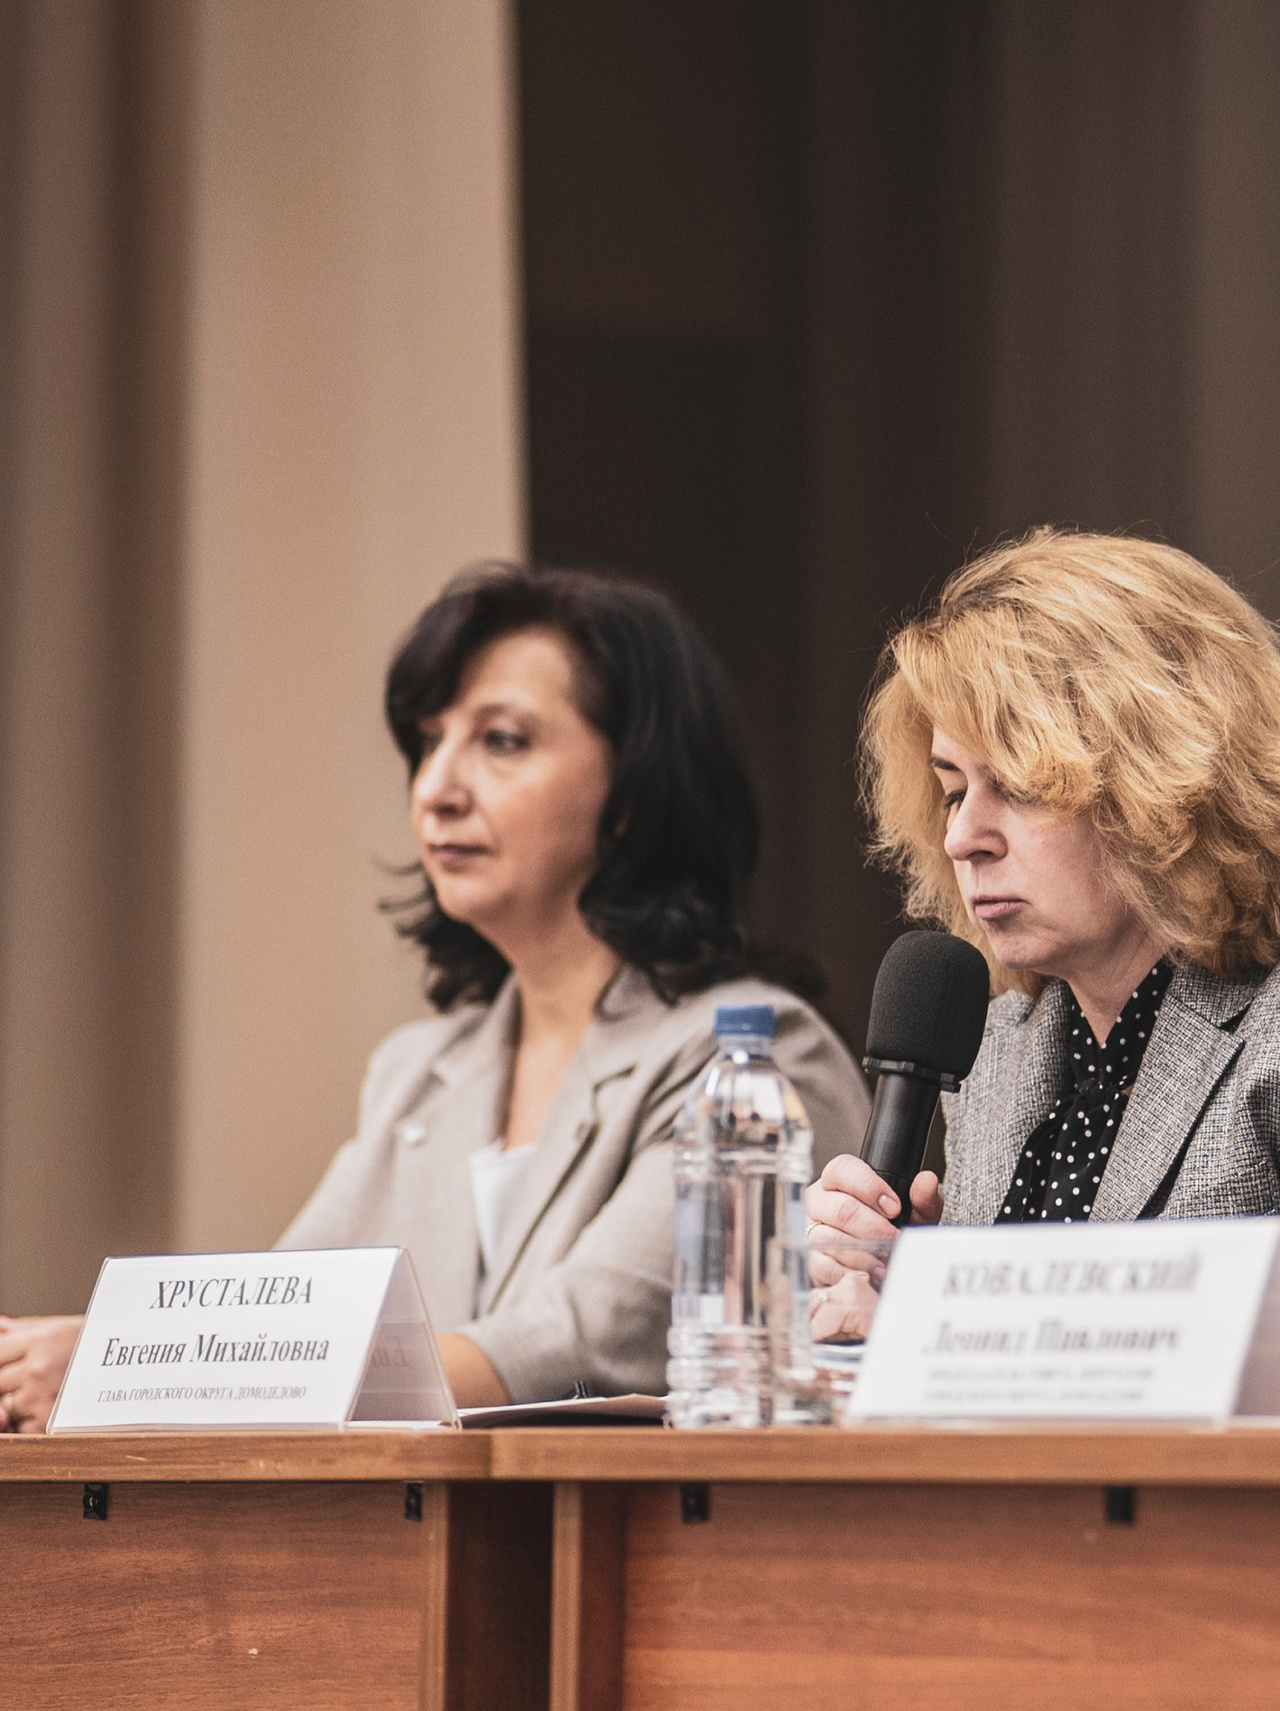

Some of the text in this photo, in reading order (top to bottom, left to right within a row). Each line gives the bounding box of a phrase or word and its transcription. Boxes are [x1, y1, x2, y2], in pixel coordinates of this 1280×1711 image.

[149, 1275, 314, 1309] ХРУСТАЛЕВА
[101, 1333, 329, 1367] Евгения Михайловна
[98, 1386, 307, 1403] ГЛАВА ГОРОДСКОГО ОКРУГА ДОМОДЕДОВО
